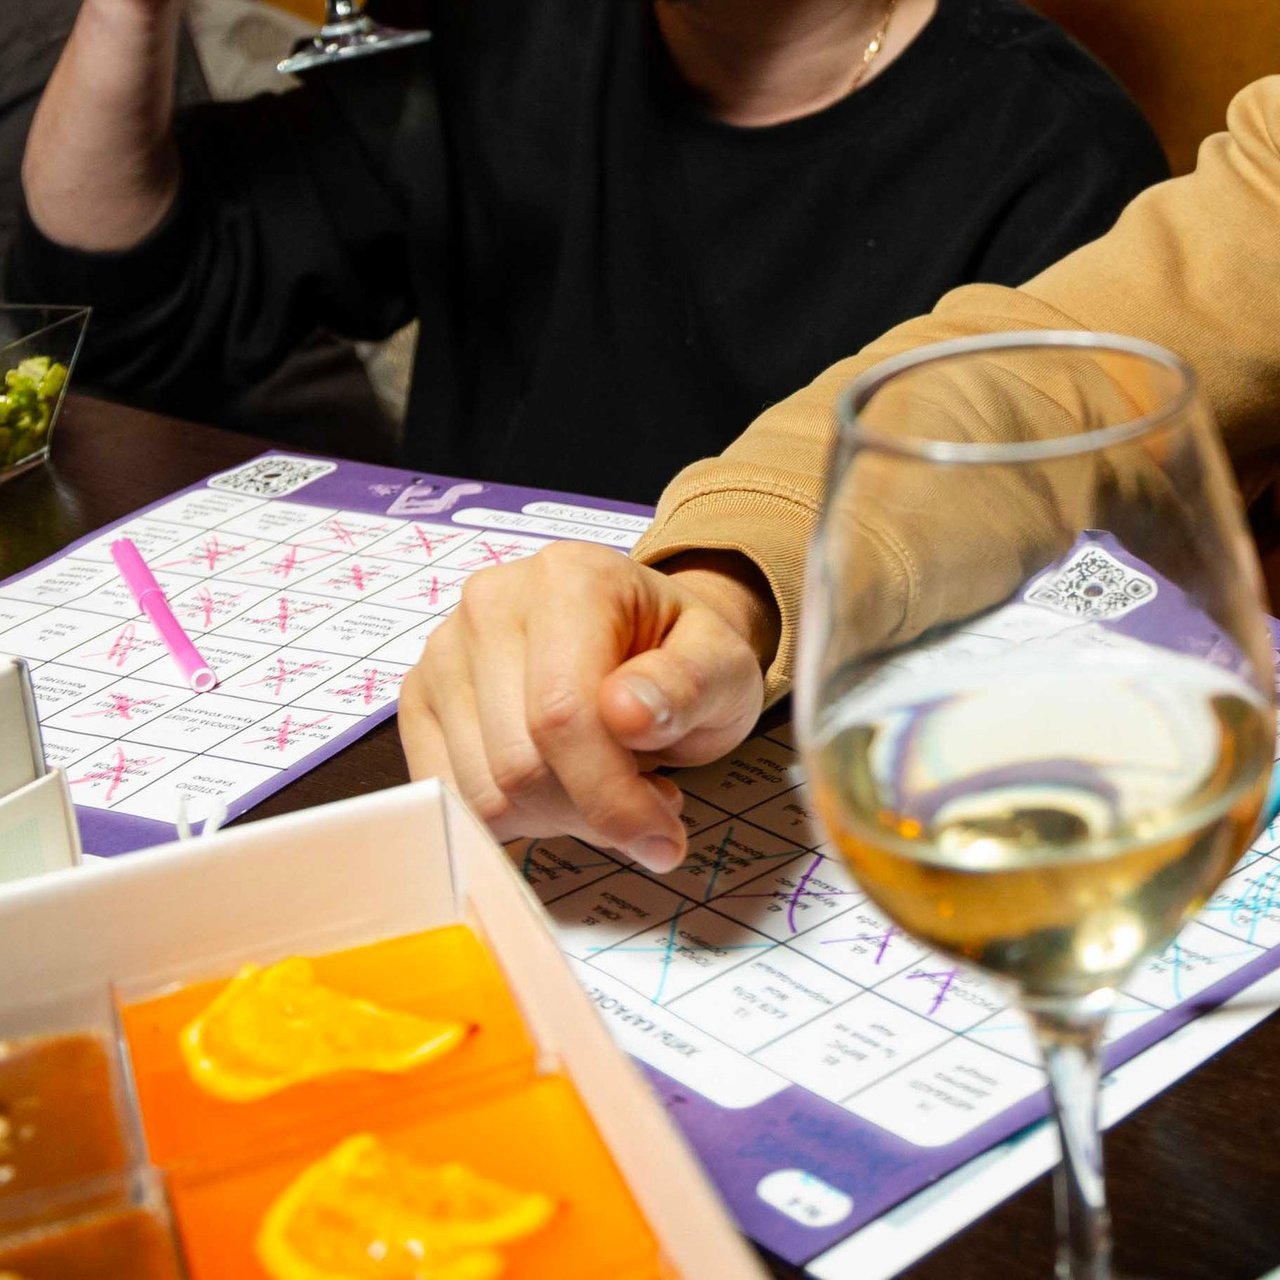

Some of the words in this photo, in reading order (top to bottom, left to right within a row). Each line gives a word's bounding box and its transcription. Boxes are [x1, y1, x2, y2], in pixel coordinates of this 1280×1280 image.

[546, 523, 612, 538] ПИТЕРЕ
[178, 706, 222, 717] колдуна
[199, 719, 242, 730] КОРОЛЬ
[222, 714, 255, 723] Кукла
[586, 988, 655, 1031] КАРАОКЕ
[654, 1030, 701, 1058] ХИТЫ
